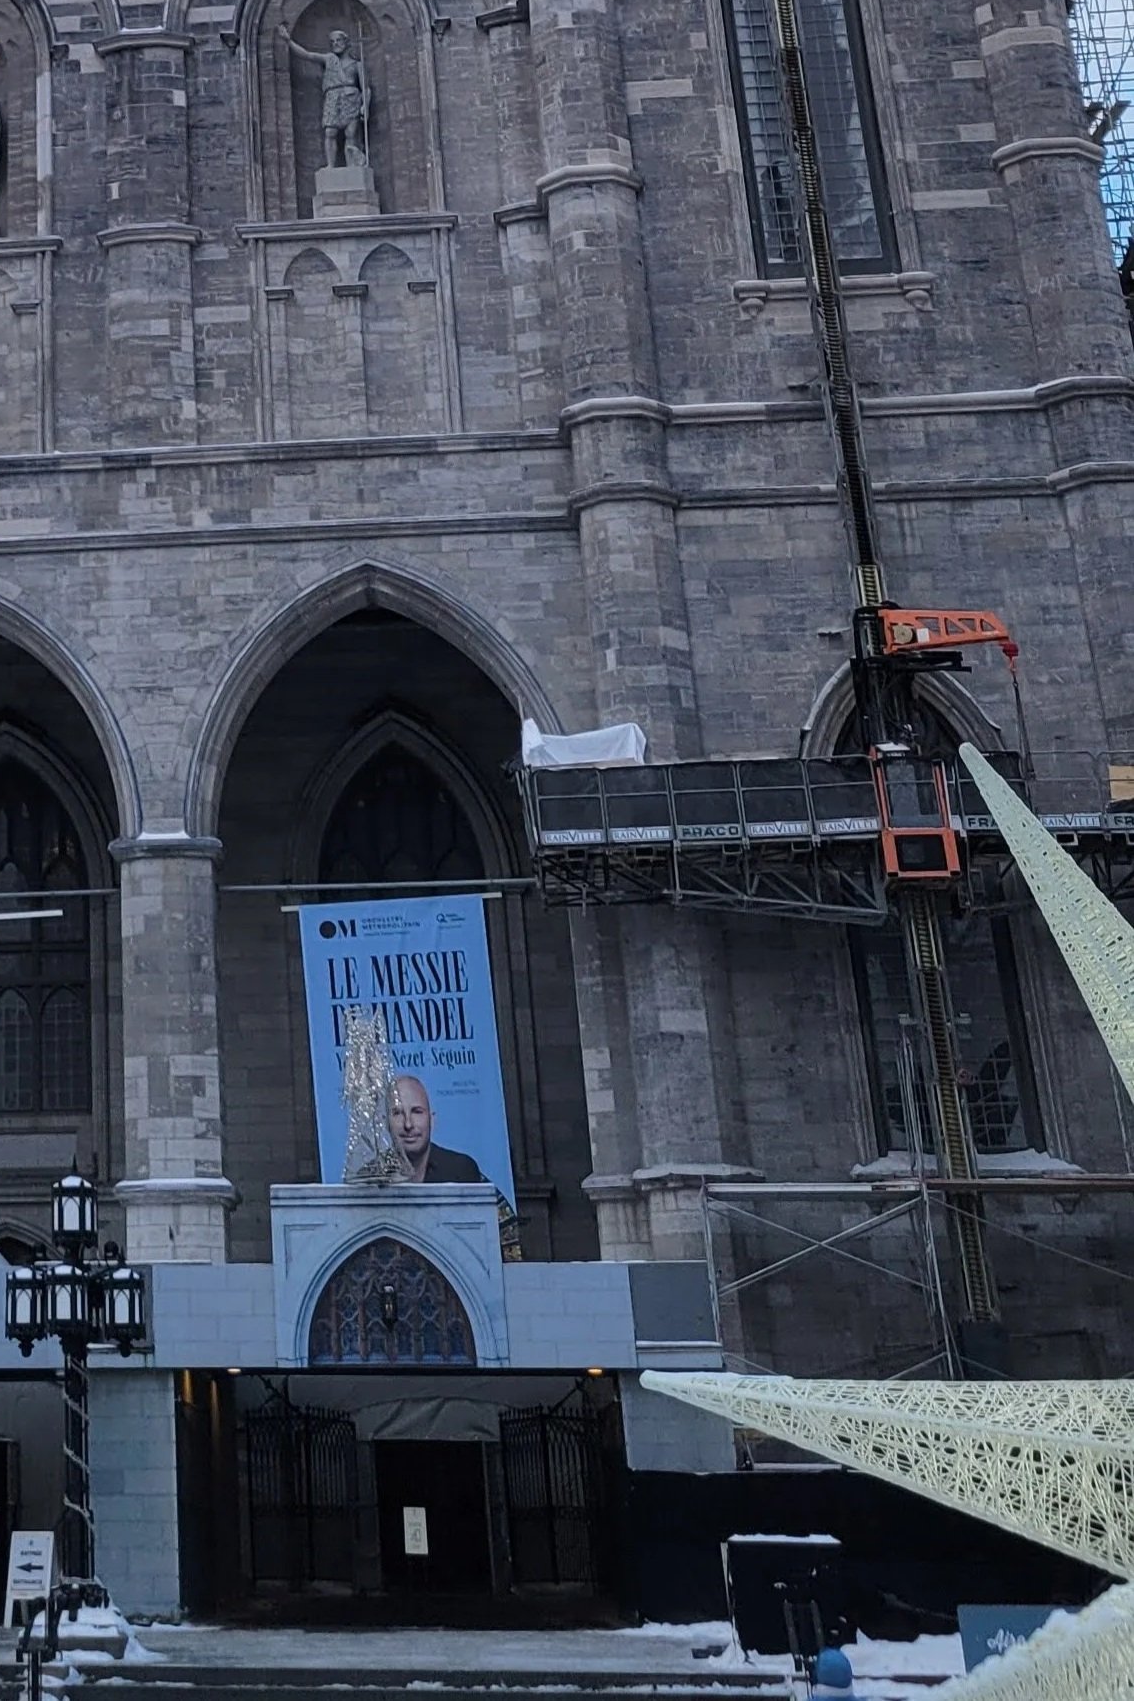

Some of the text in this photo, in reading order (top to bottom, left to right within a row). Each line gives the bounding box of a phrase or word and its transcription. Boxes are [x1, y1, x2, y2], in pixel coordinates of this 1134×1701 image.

[682, 825, 739, 837] FRACO
[752, 822, 808, 835] RAINVILLE
[820, 818, 878, 832] RAINVILLE
[327, 950, 469, 999] LE MESSIE
